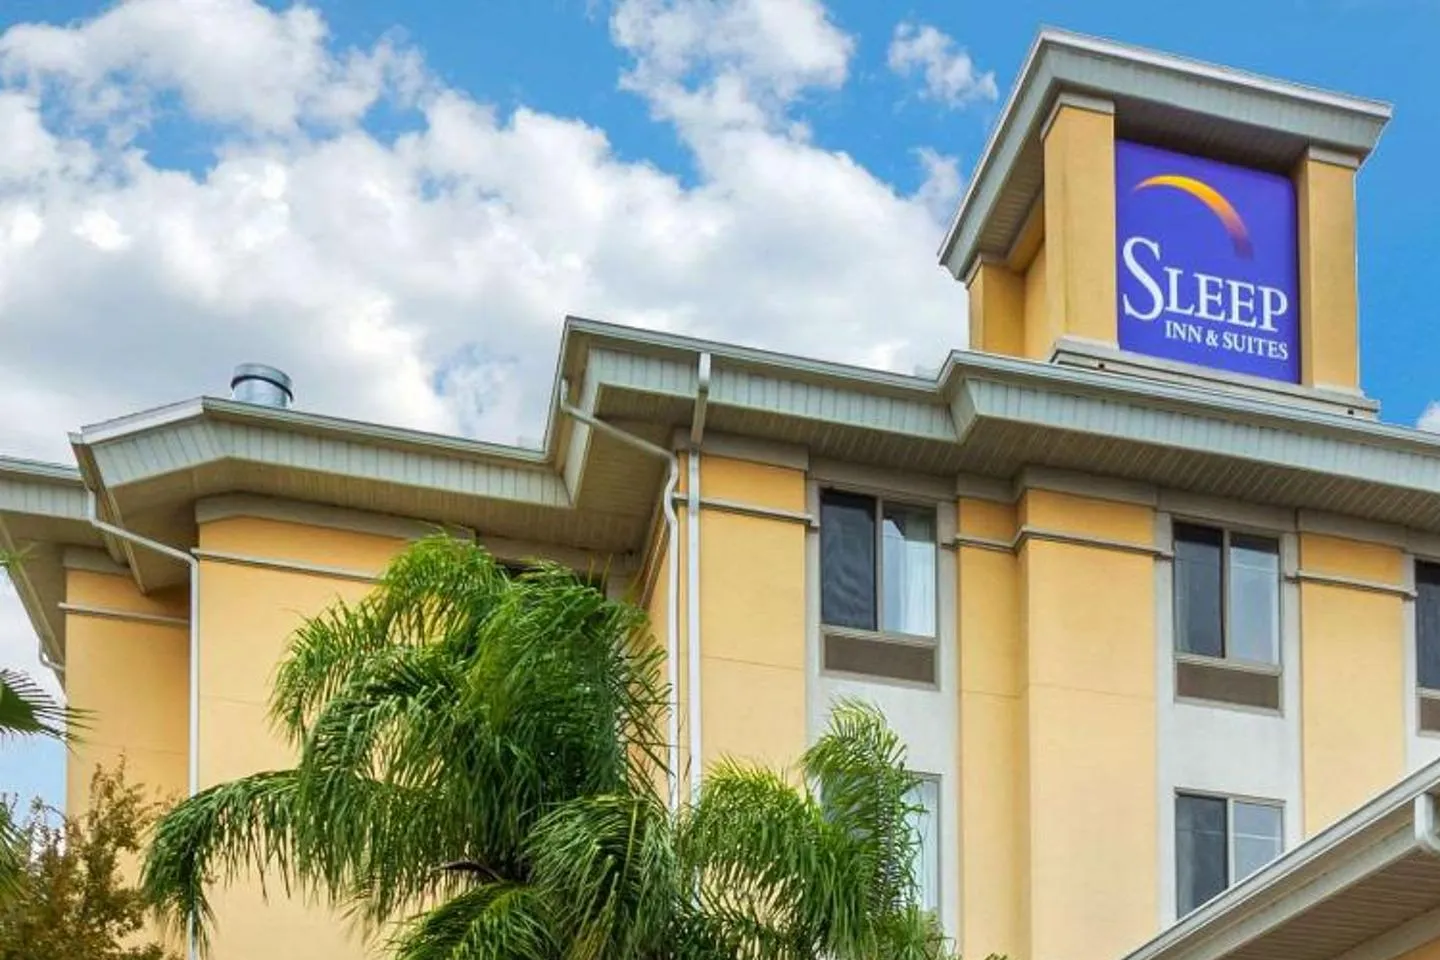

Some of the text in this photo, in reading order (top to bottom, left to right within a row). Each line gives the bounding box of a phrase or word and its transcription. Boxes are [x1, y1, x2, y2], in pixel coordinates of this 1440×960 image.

[1123, 237, 1288, 332] SLEEP
[1166, 320, 1288, 360] INN & SUITES
